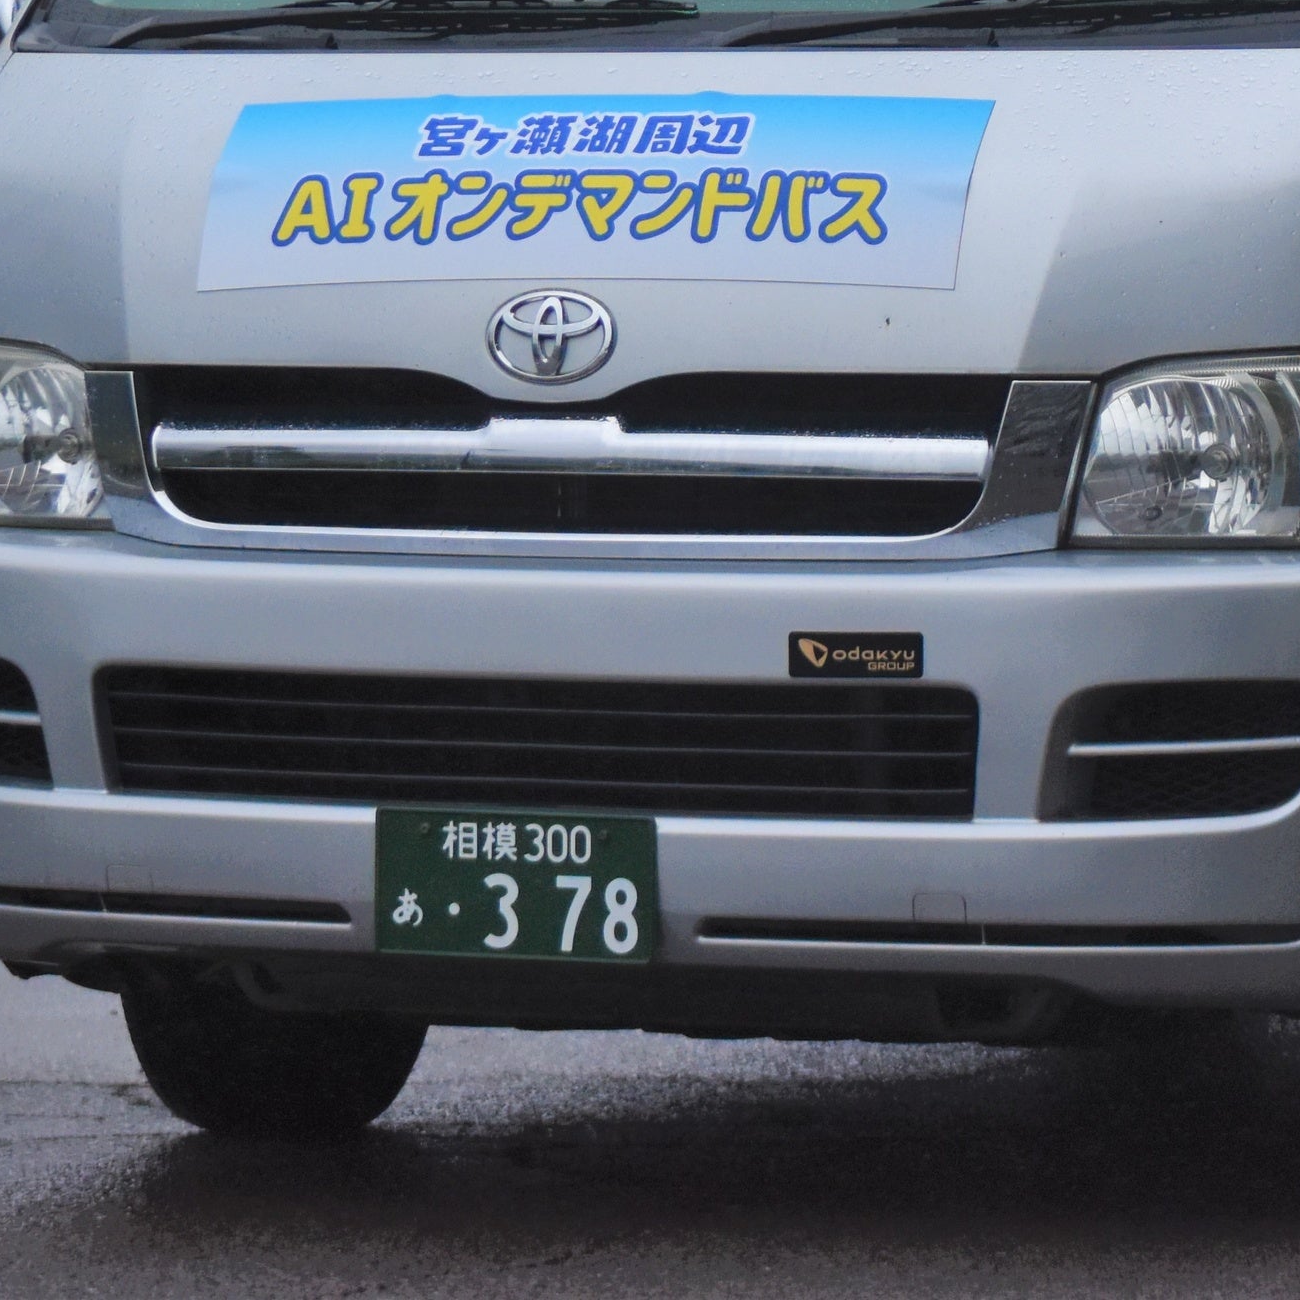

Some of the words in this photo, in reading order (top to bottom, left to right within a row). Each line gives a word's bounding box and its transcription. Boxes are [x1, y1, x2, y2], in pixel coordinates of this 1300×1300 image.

[416, 113, 750, 157] 宮ヶ瀬湖周辺
[832, 646, 915, 661] odakyu
[867, 661, 915, 671] GROUP
